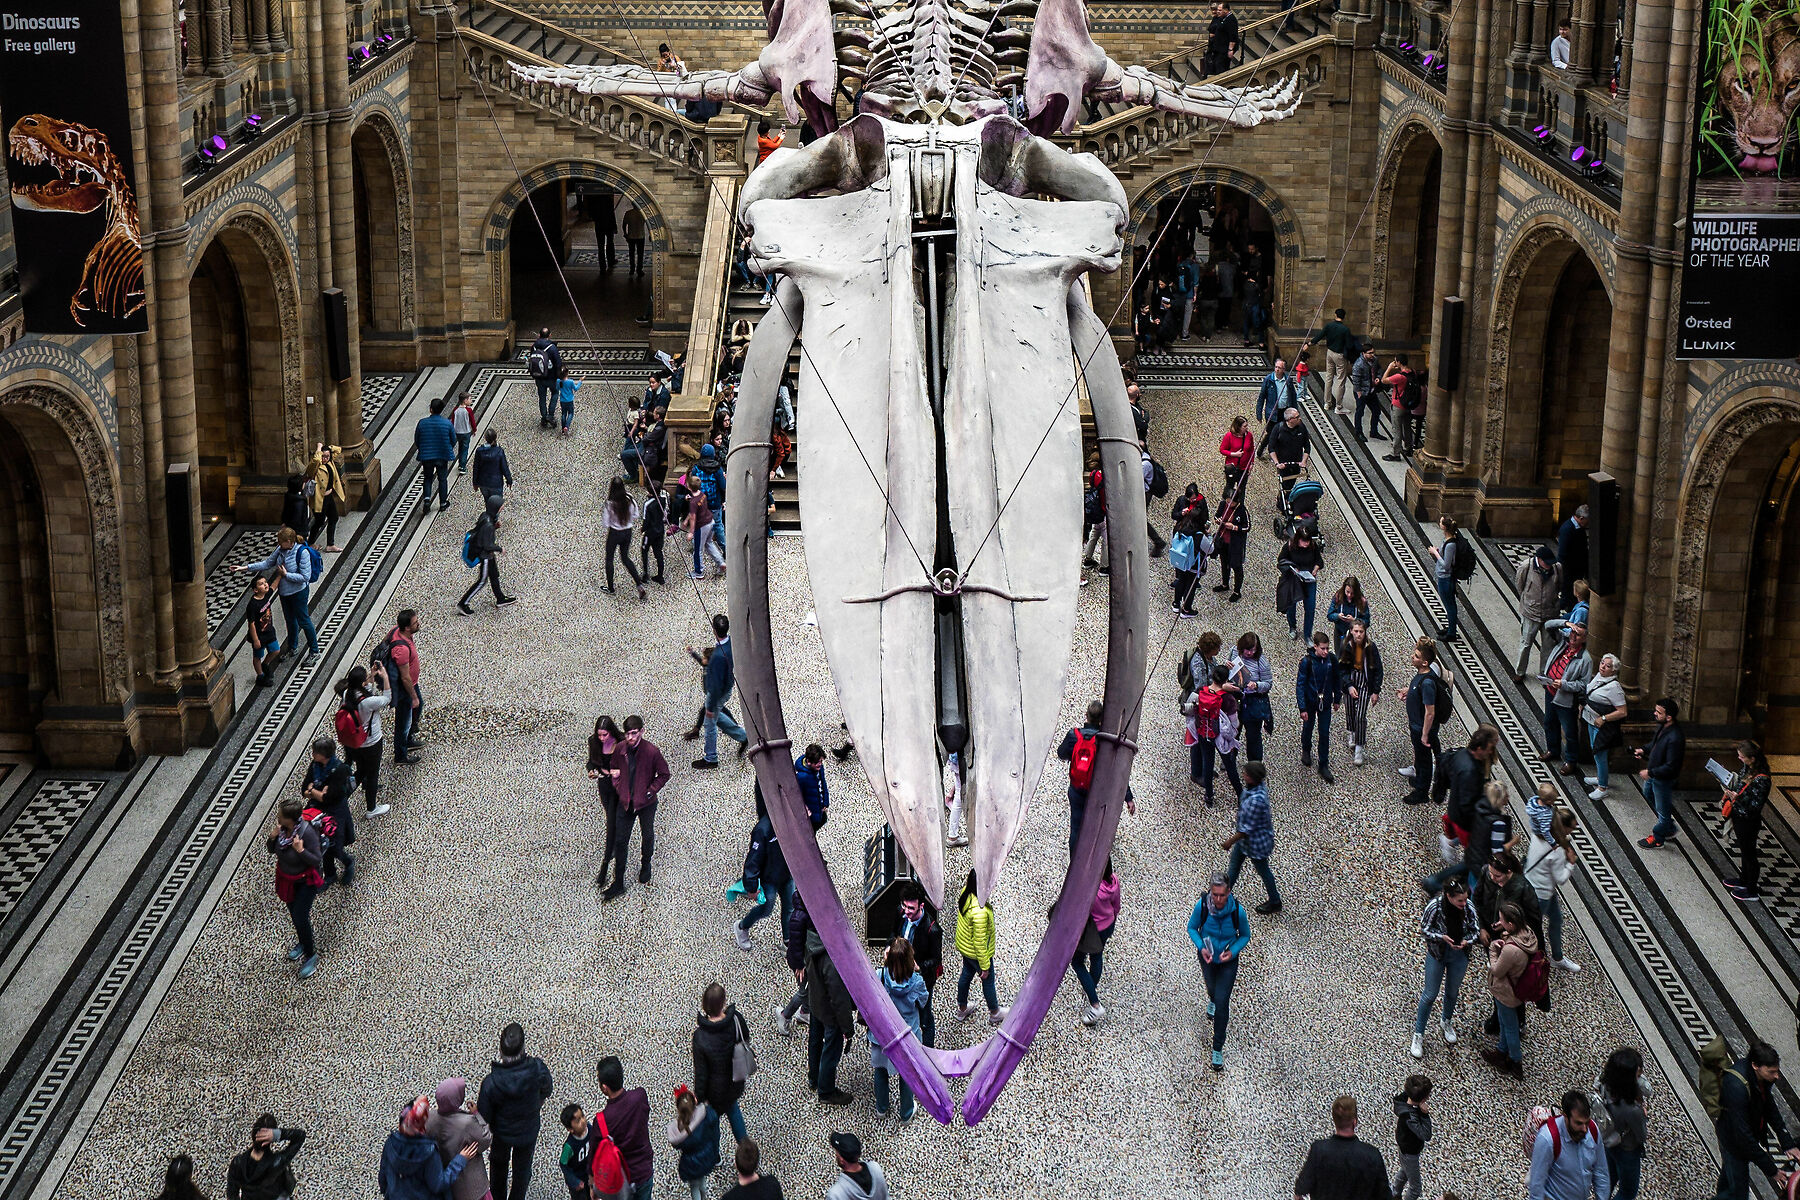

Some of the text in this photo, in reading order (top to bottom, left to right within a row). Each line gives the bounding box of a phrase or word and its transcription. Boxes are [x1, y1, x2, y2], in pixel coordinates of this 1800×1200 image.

[2, 13, 81, 30] Dinosaurs
[4, 37, 76, 55] Free gallery
[1692, 221, 1758, 235] WILDLIFE
[1690, 253, 1770, 268] OF THE YEAR
[1682, 338, 1736, 351] LUMIX
